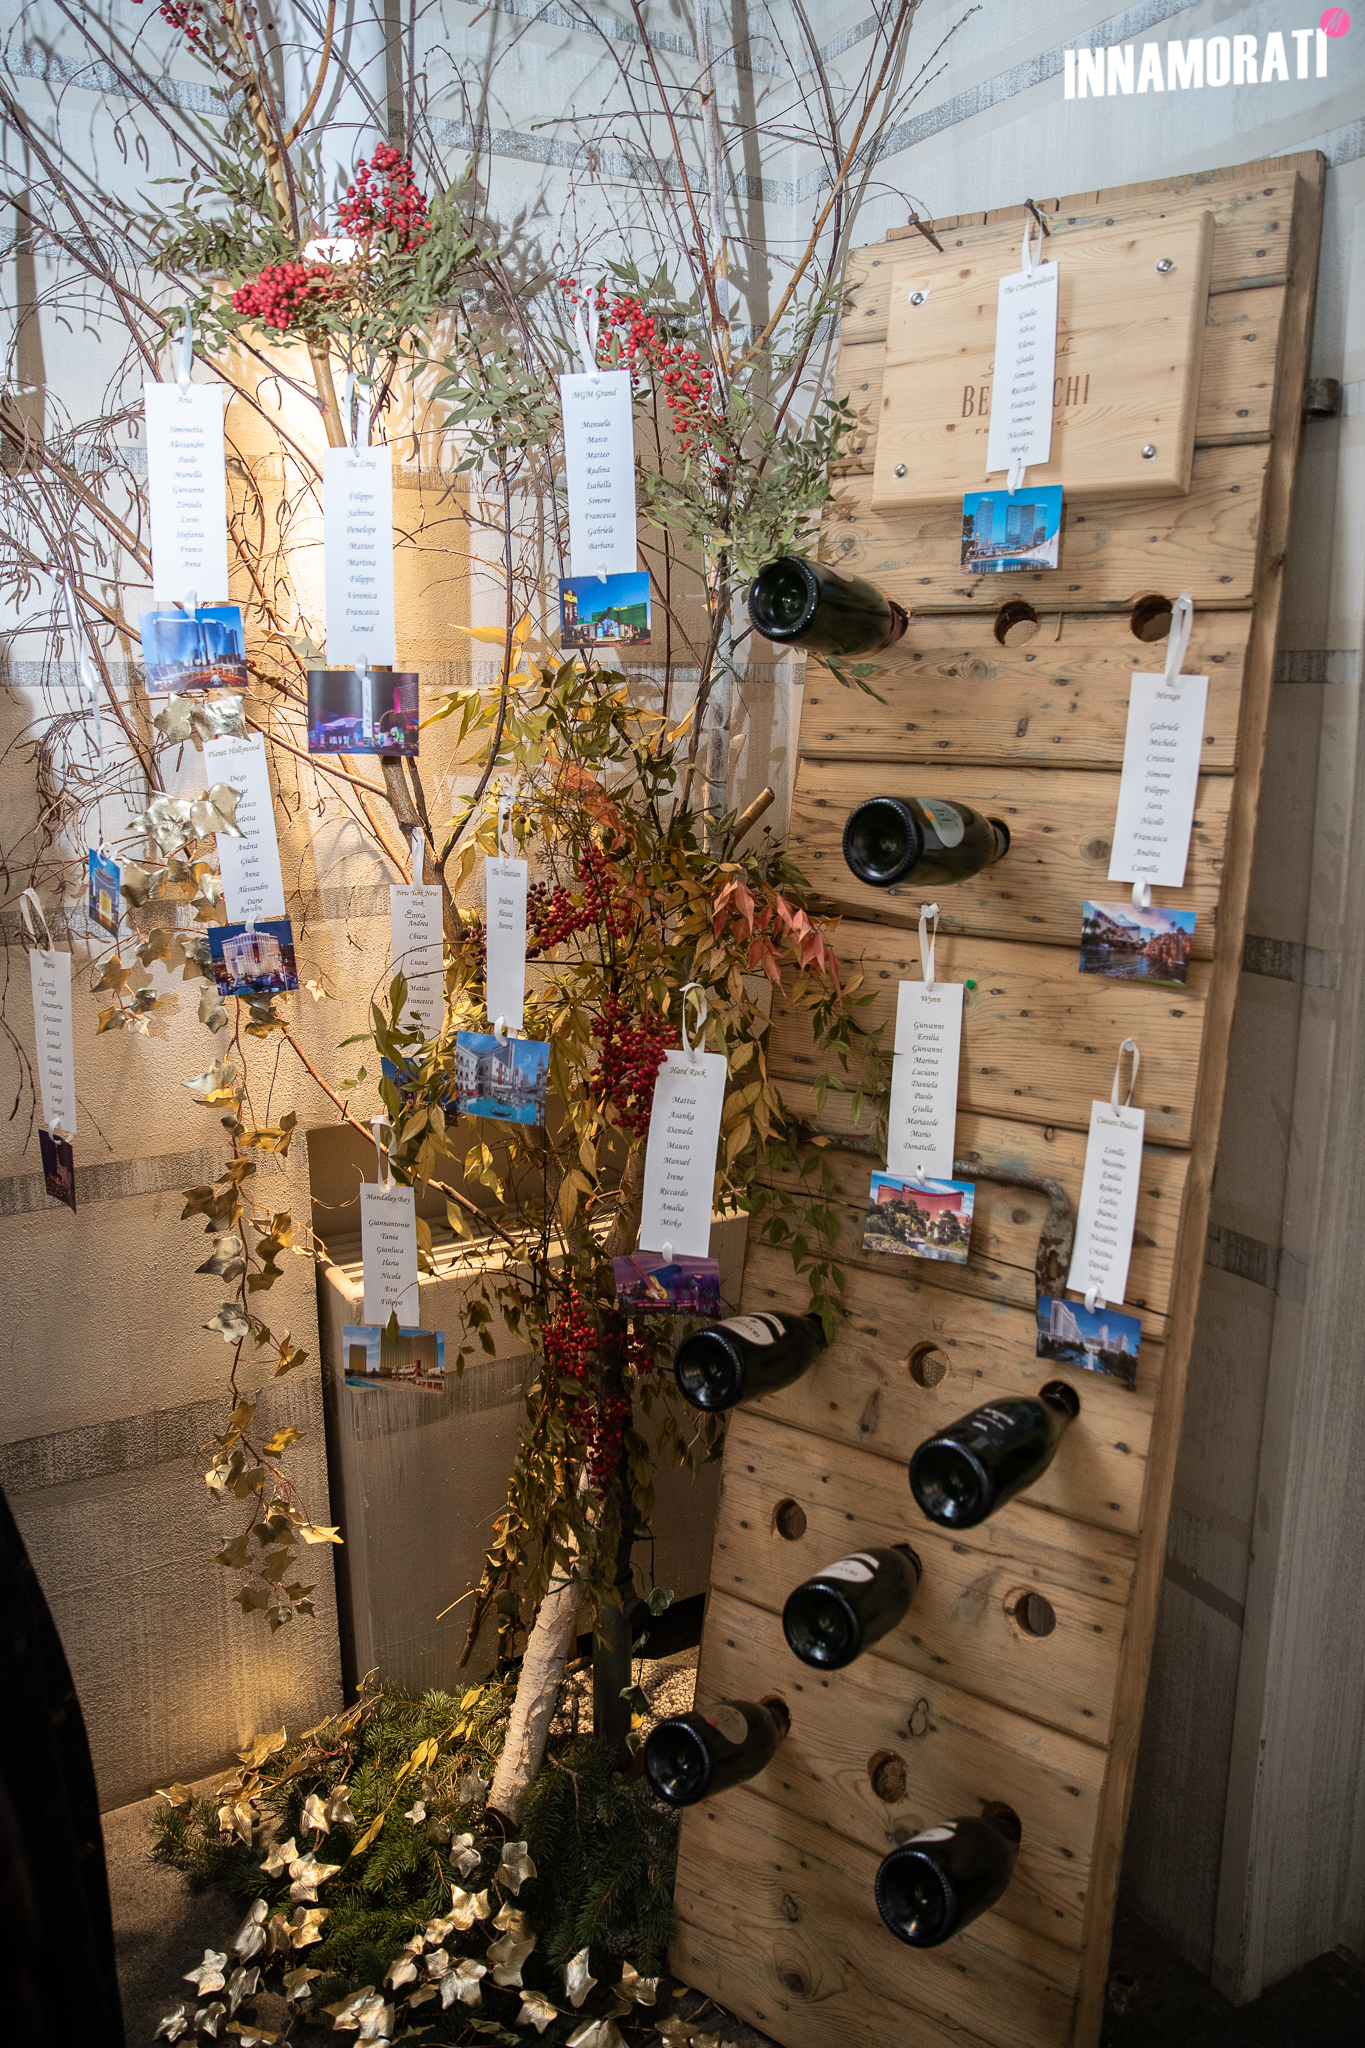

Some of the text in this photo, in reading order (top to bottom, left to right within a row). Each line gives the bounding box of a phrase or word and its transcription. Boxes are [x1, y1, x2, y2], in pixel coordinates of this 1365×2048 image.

[572, 388, 617, 400] MGM Grand
[581, 419, 611, 429] Manuela
[587, 480, 612, 490] Isabella
[349, 492, 374, 502] Filippo
[347, 509, 374, 517] Sabrina
[584, 512, 616, 520] Francesca
[346, 525, 376, 535] Penelope
[587, 526, 614, 537] Gabriele
[176, 531, 204, 540] Stefania
[588, 541, 614, 550] Barbara
[349, 575, 375, 585] Filippo
[347, 591, 377, 599] Veronica
[345, 608, 379, 616] Francesca
[1154, 692, 1181, 702] Mirage
[1150, 723, 1179, 732] Gabriele
[1148, 738, 1177, 747] Michela
[208, 743, 261, 758] Planet Hollywood
[1146, 754, 1175, 763] Cristina
[229, 774, 247, 782] Diego
[1145, 770, 1172, 779] Simone
[1144, 786, 1169, 796] Filippo
[1145, 802, 1162, 810] Sara
[1133, 832, 1167, 842] Francesca
[236, 842, 258, 852] Andrea
[1133, 848, 1160, 857] Andrea
[240, 856, 259, 867] Giulia
[1131, 864, 1159, 873] Camilla
[243, 871, 259, 879] Anna
[237, 882, 269, 894] Alessandro
[404, 909, 426, 919] Emma
[914, 1021, 945, 1030] Giovanni
[912, 1045, 943, 1053] Giovanni
[913, 1057, 939, 1065] Marina
[669, 1067, 707, 1078] Hard Rock
[911, 1068, 939, 1076] Luciano
[911, 1080, 938, 1088] Daniela
[672, 1096, 696, 1105] Mattia
[914, 1092, 933, 1100] Paolo
[912, 1105, 933, 1114] Giulia
[905, 1117, 939, 1127] Mariasole
[666, 1126, 693, 1135] Daniela
[910, 1130, 932, 1138] Mario
[666, 1142, 690, 1150] Mauro
[903, 1142, 936, 1152] Donatella
[663, 1157, 691, 1166] Manuel
[666, 1172, 684, 1181] Irene
[659, 1187, 689, 1197] Riccardo
[366, 1194, 411, 1205] Mandalay Bay
[659, 1203, 684, 1212] Amalia
[368, 1219, 410, 1228] Giannantonio
[660, 1219, 682, 1229] Mirko
[376, 1246, 404, 1254] Gianluca
[380, 1272, 401, 1280] Nicola
